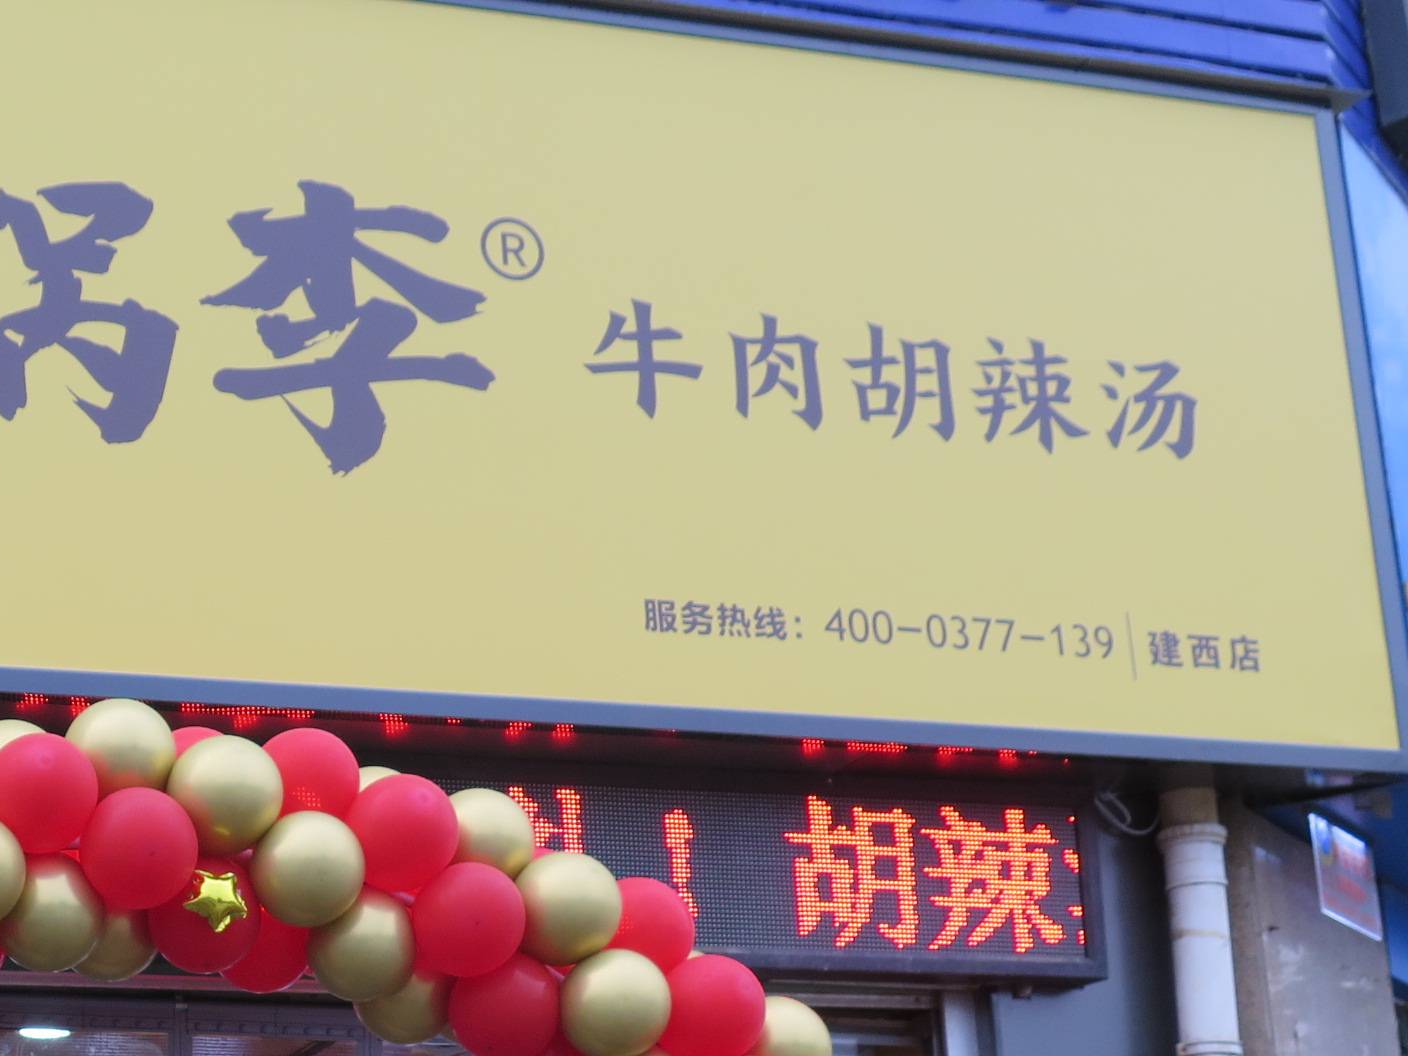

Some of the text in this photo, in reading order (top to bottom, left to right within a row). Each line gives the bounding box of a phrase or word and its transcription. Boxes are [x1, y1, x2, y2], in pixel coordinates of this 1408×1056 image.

[583, 298, 1198, 460] 牛肉胡辣汤
[1148, 630, 1261, 673] 建西店
[783, 794, 1087, 953] 胡辣
